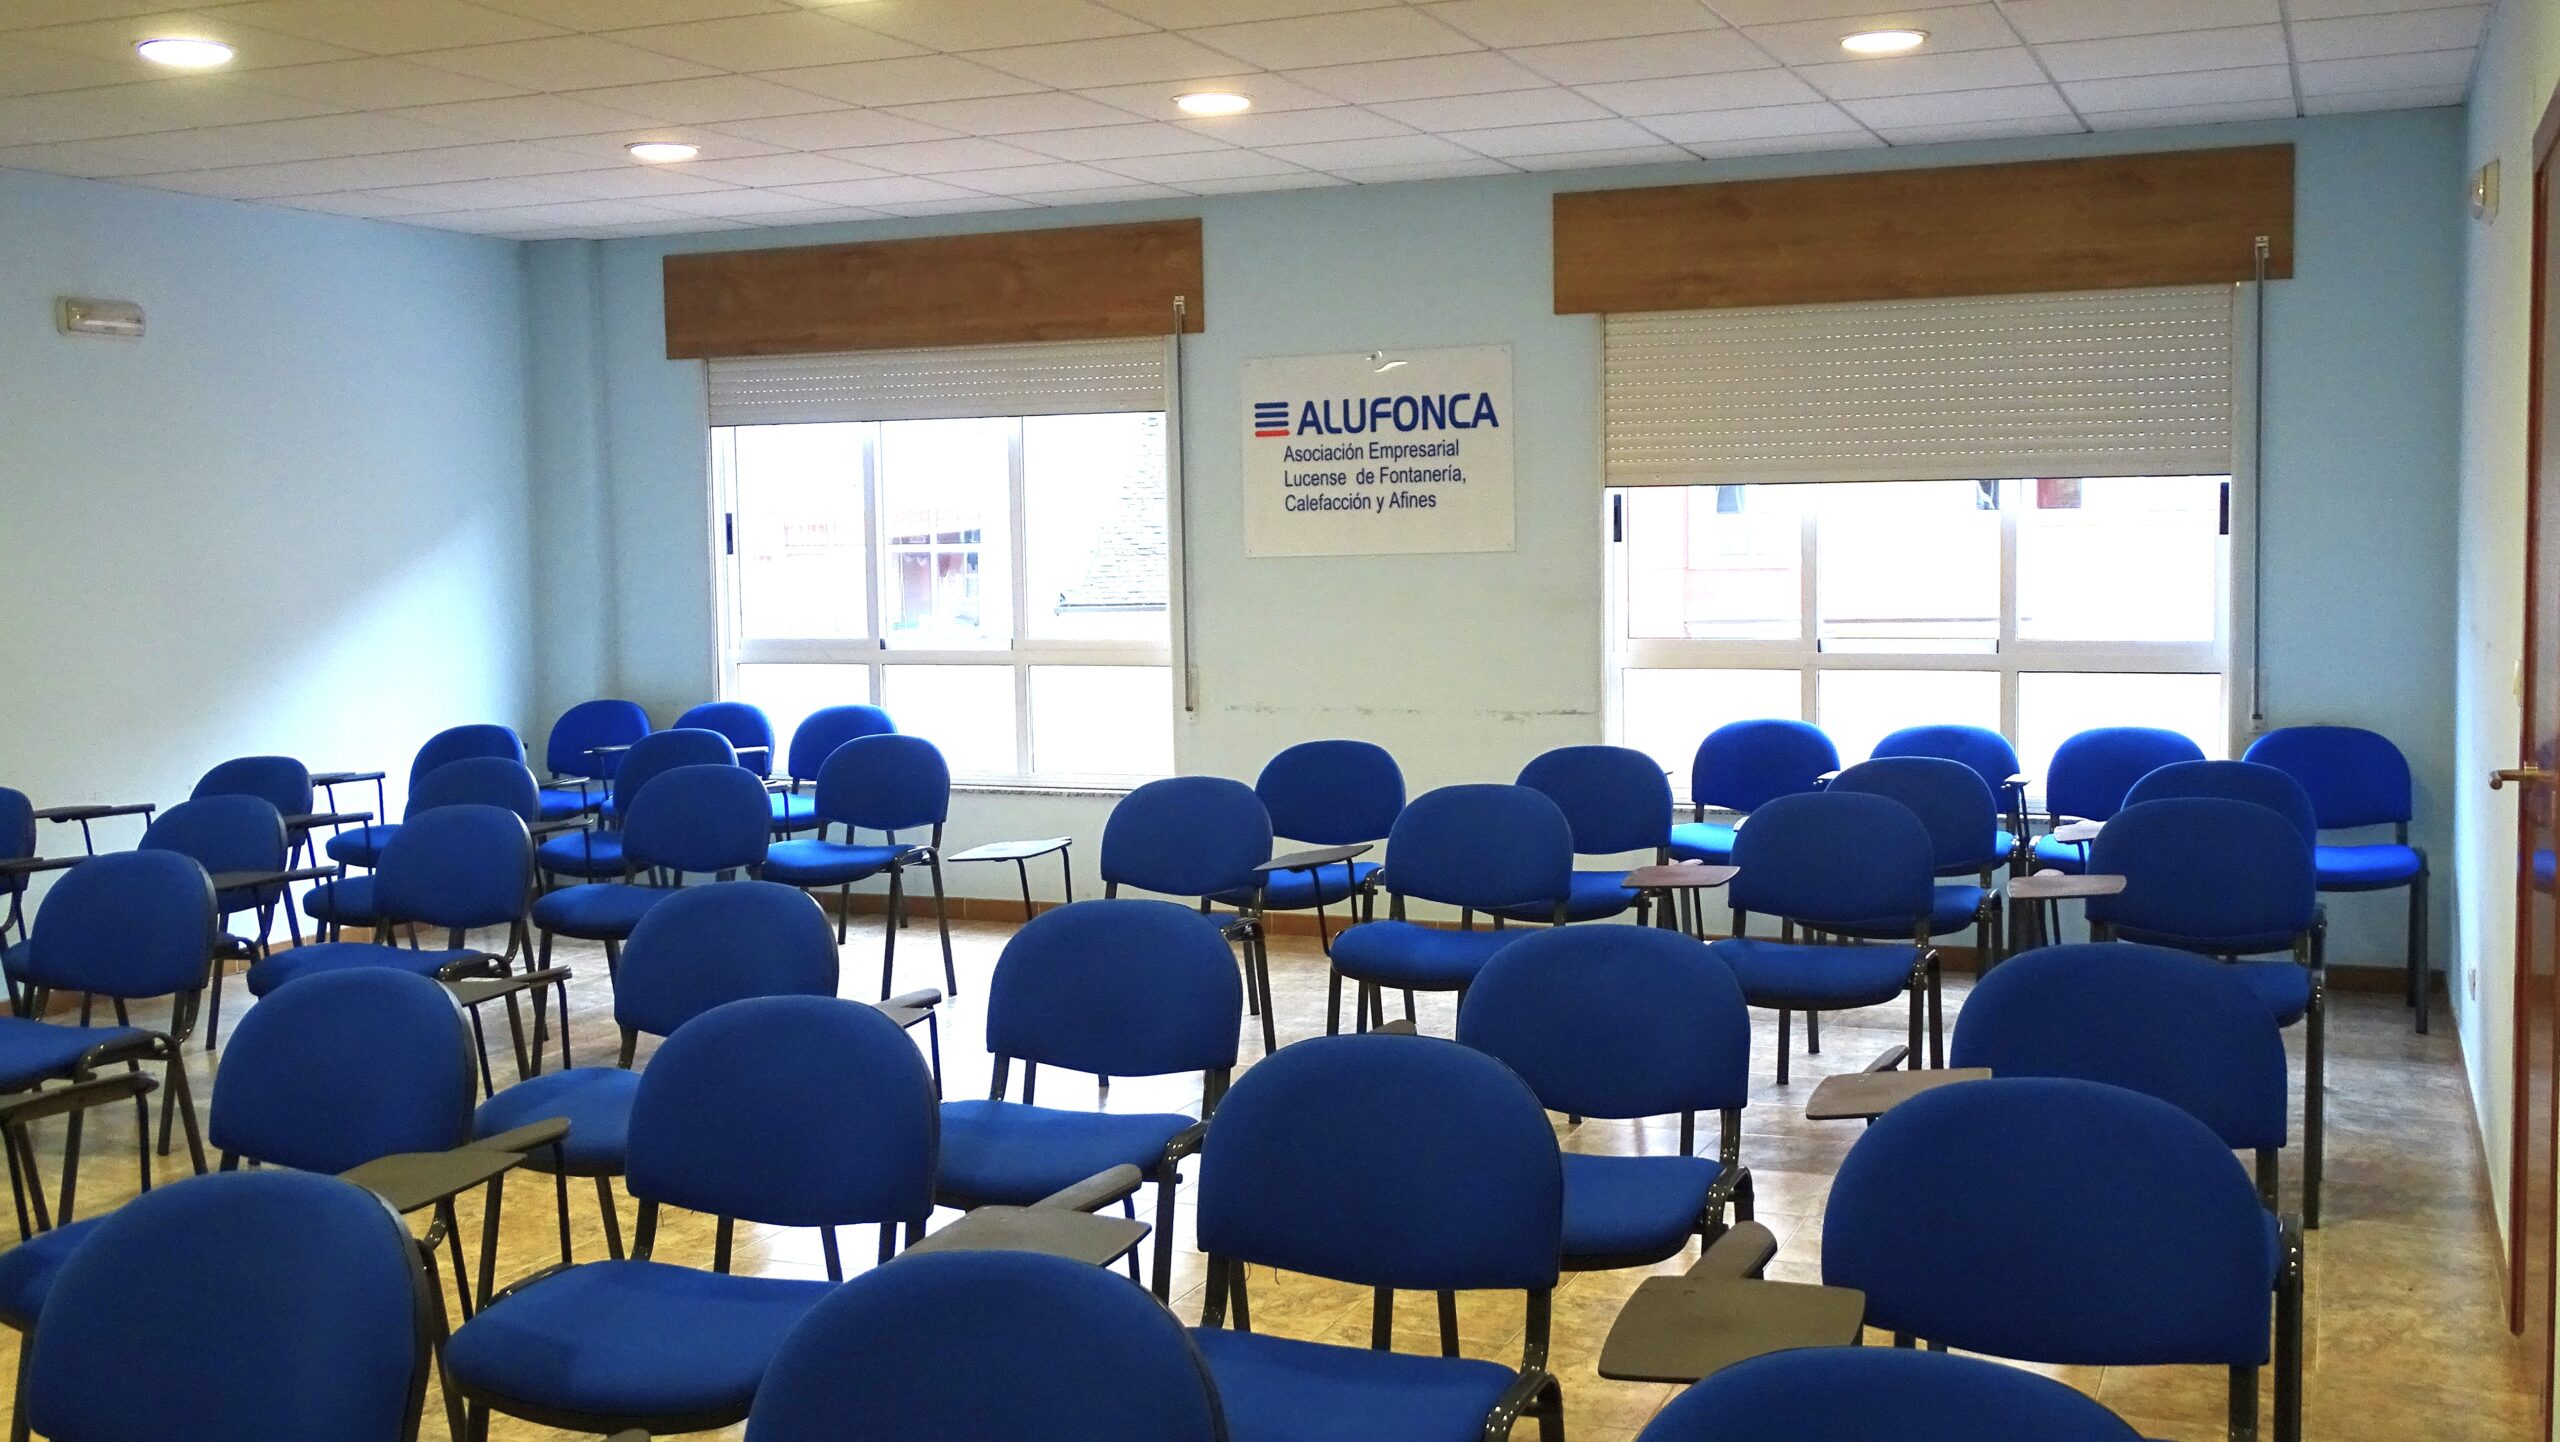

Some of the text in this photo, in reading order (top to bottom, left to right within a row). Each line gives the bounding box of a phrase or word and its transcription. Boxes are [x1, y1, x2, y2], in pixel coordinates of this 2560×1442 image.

[1297, 392, 1499, 435] ALUFONCA
[1283, 439, 1459, 462] Asociación Empresarial
[1284, 465, 1466, 487] Lucense de Fontanería,
[1285, 492, 1436, 513] Calefacción y Afines
